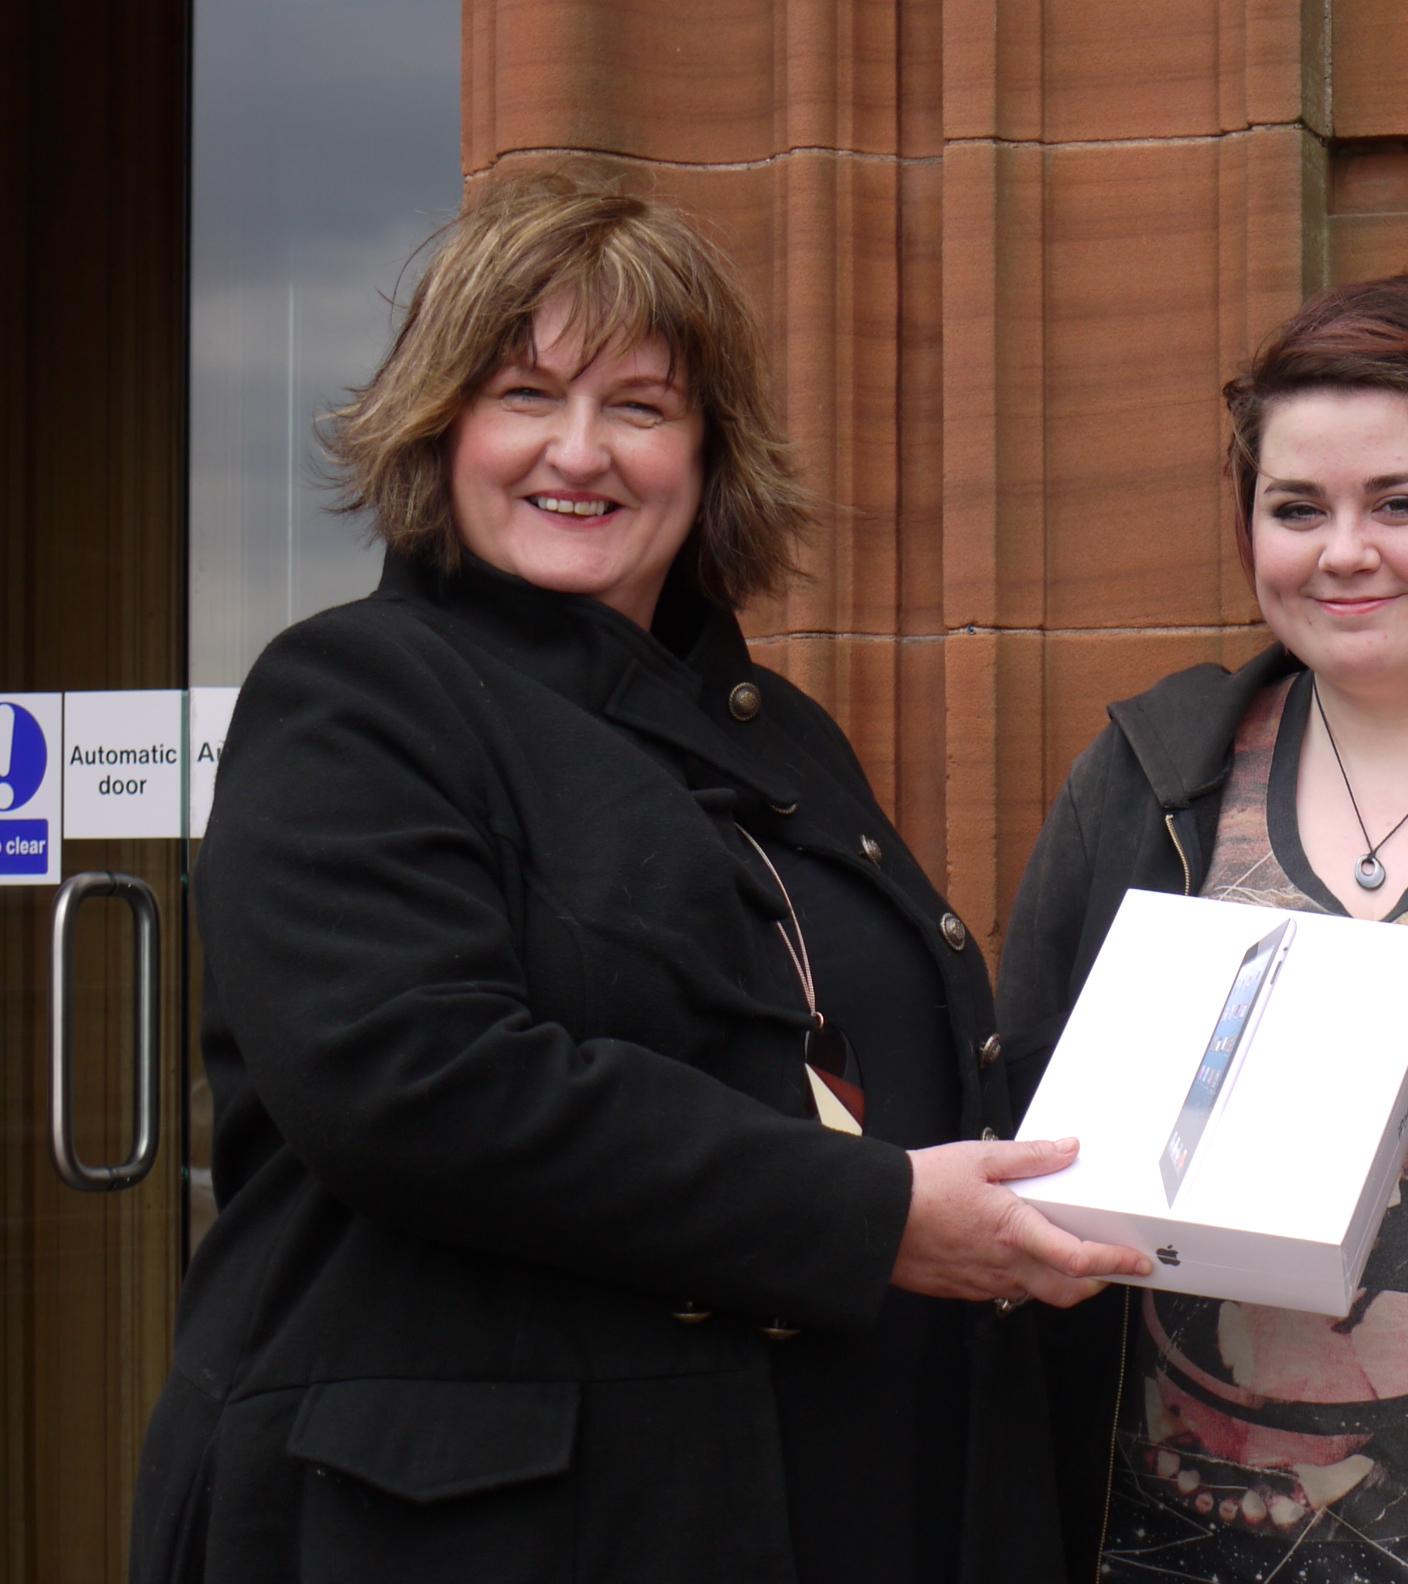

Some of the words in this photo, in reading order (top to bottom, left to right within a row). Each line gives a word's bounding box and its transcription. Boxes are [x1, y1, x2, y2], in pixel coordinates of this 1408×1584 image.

[70, 744, 177, 766] Automatic
[98, 775, 147, 795] door
[6, 836, 46, 855] clear
